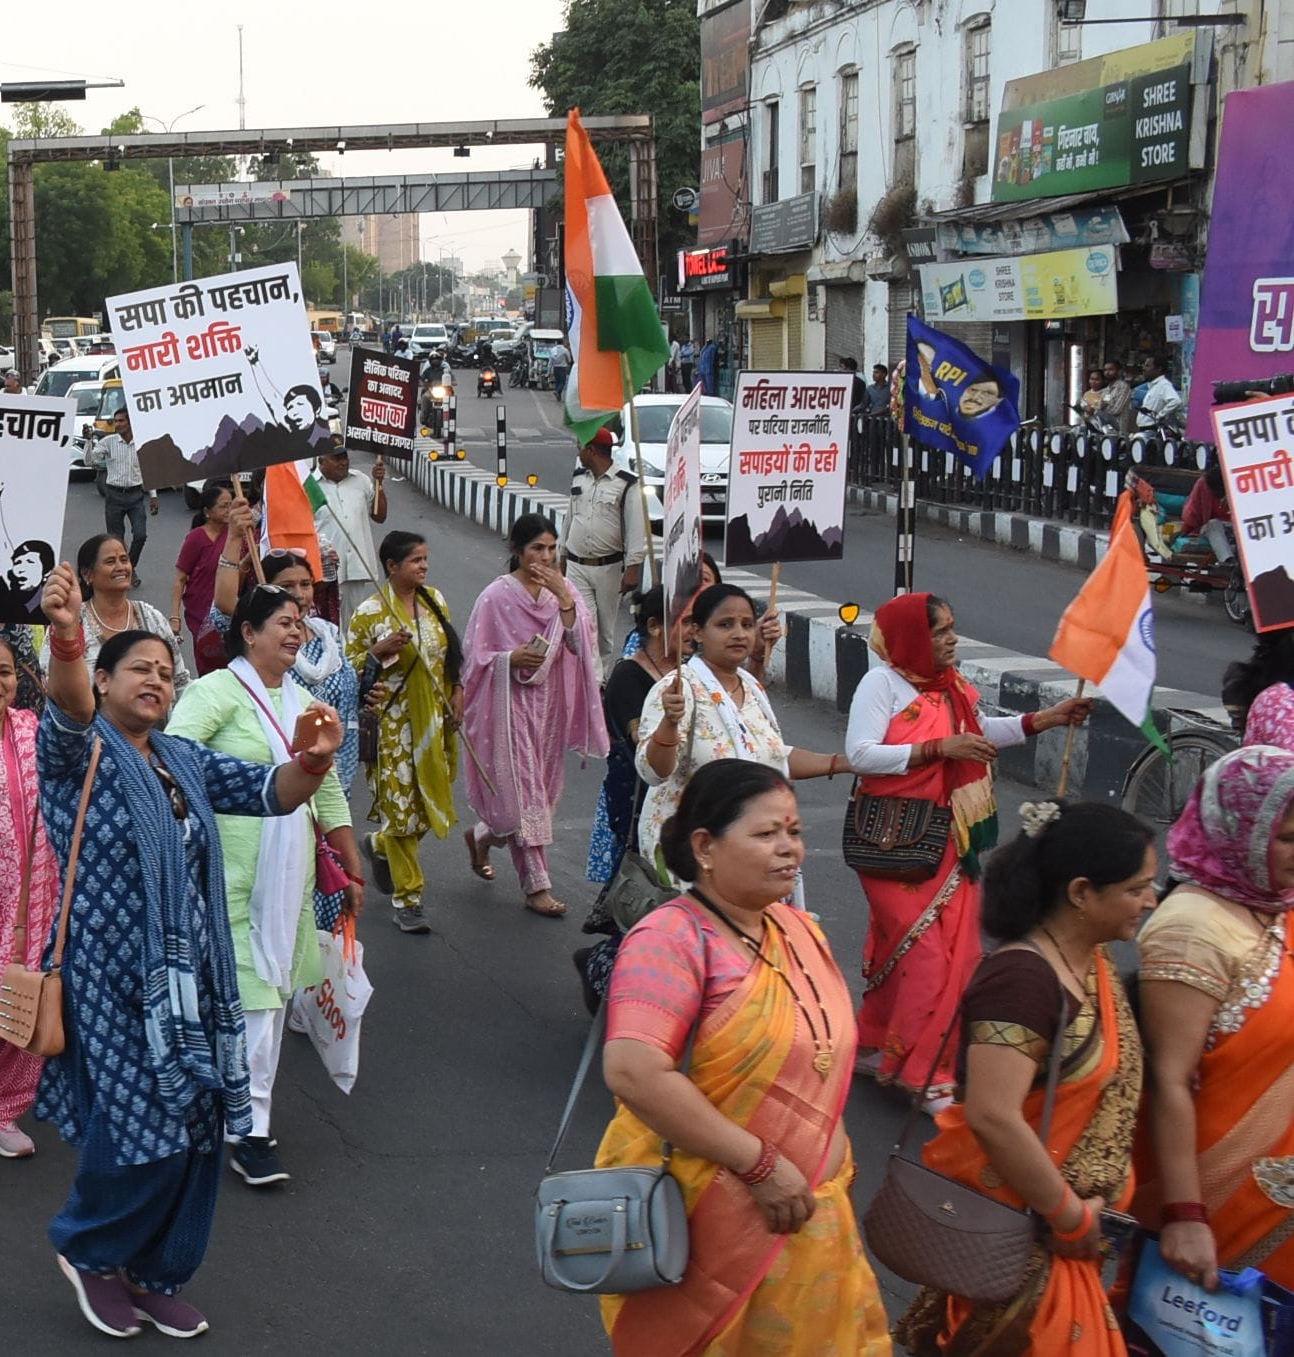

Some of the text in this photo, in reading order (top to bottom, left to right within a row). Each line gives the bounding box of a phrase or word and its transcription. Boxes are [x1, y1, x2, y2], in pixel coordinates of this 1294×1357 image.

[1143, 80, 1176, 108] SHREE
[1135, 110, 1183, 139] KRISHNA
[1141, 142, 1176, 168] STORE
[115, 273, 300, 331] सपा की पहचान,
[122, 321, 243, 372] नारी शक्ति
[363, 359, 410, 383] सैनिक परिवार
[935, 361, 968, 387] RPI
[132, 372, 243, 413] का अपमान
[367, 380, 403, 400] का अनादर,
[742, 379, 847, 410] महिला आरक्षण
[361, 397, 408, 429] सपा का
[748, 415, 832, 437] पर घटिया राजनीति,
[347, 426, 372, 441] असली
[372, 428, 390, 445] चेहरा
[1223, 411, 1278, 447] सपा
[739, 442, 839, 476] सपाइयों की रही
[1231, 449, 1294, 495] नारी
[757, 480, 814, 508] पुरानी निति
[1243, 513, 1274, 541] का
[316, 978, 346, 1042] Shop
[1161, 1286, 1243, 1332] Leeford
